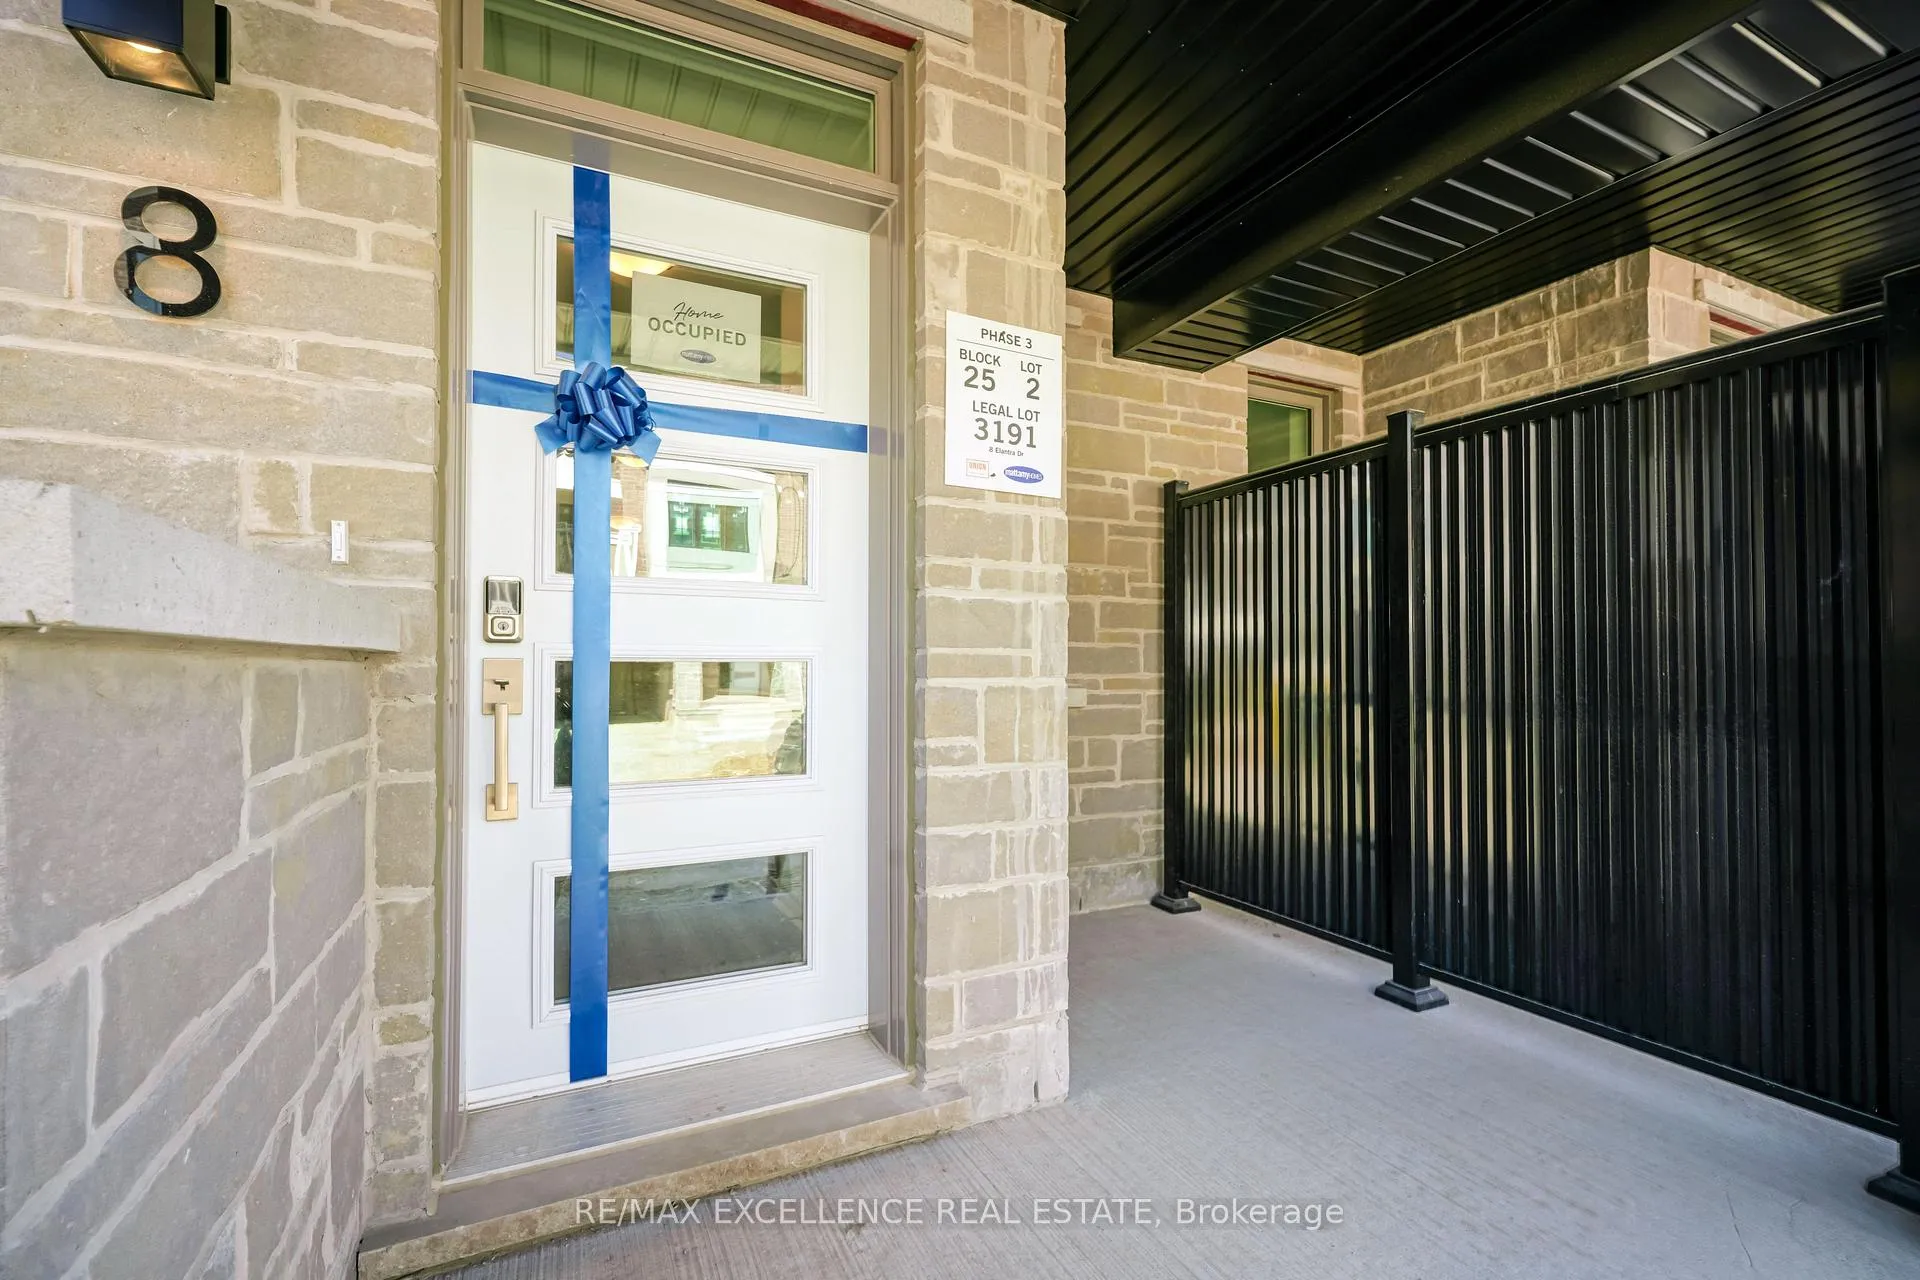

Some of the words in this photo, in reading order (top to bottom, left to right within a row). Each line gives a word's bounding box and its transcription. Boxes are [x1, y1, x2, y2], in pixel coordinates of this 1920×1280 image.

[114, 186, 221, 317] 8
[673, 302, 724, 321] Home
[648, 317, 746, 346] OCCUPIED
[981, 328, 1021, 347] PHASE
[1025, 338, 1033, 349] 3
[959, 348, 1001, 367] BLOCK
[1020, 360, 1043, 375] LOT
[963, 365, 996, 392] 25
[1026, 377, 1040, 400] 2
[972, 400, 1013, 418] LEGAL
[1017, 407, 1041, 422] LOT
[974, 417, 1037, 448] 3191
[995, 447, 1016, 457] Elantra
